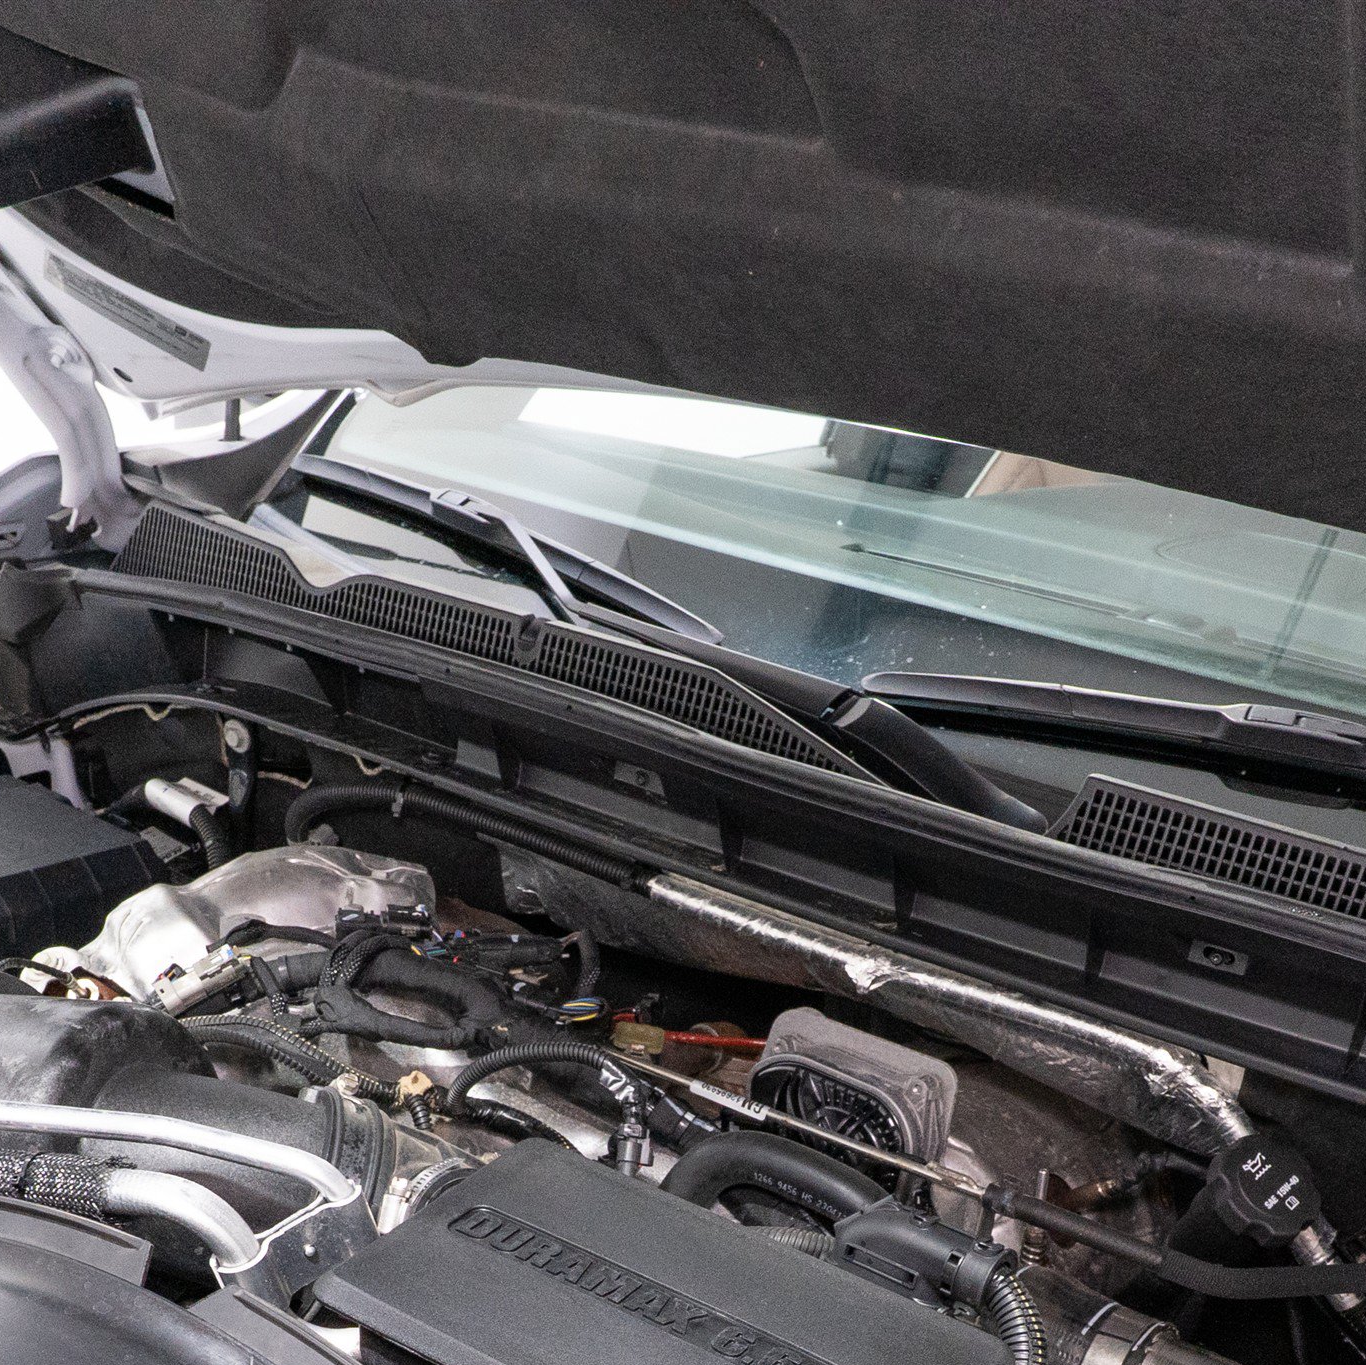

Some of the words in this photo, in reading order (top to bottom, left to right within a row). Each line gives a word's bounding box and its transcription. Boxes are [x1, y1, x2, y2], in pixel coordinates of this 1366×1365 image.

[741, 1097, 765, 1114] GM
[1264, 1194, 1279, 1210] SAE
[1276, 1174, 1300, 1198] 15W-40
[453, 1212, 708, 1335] DURAMAX
